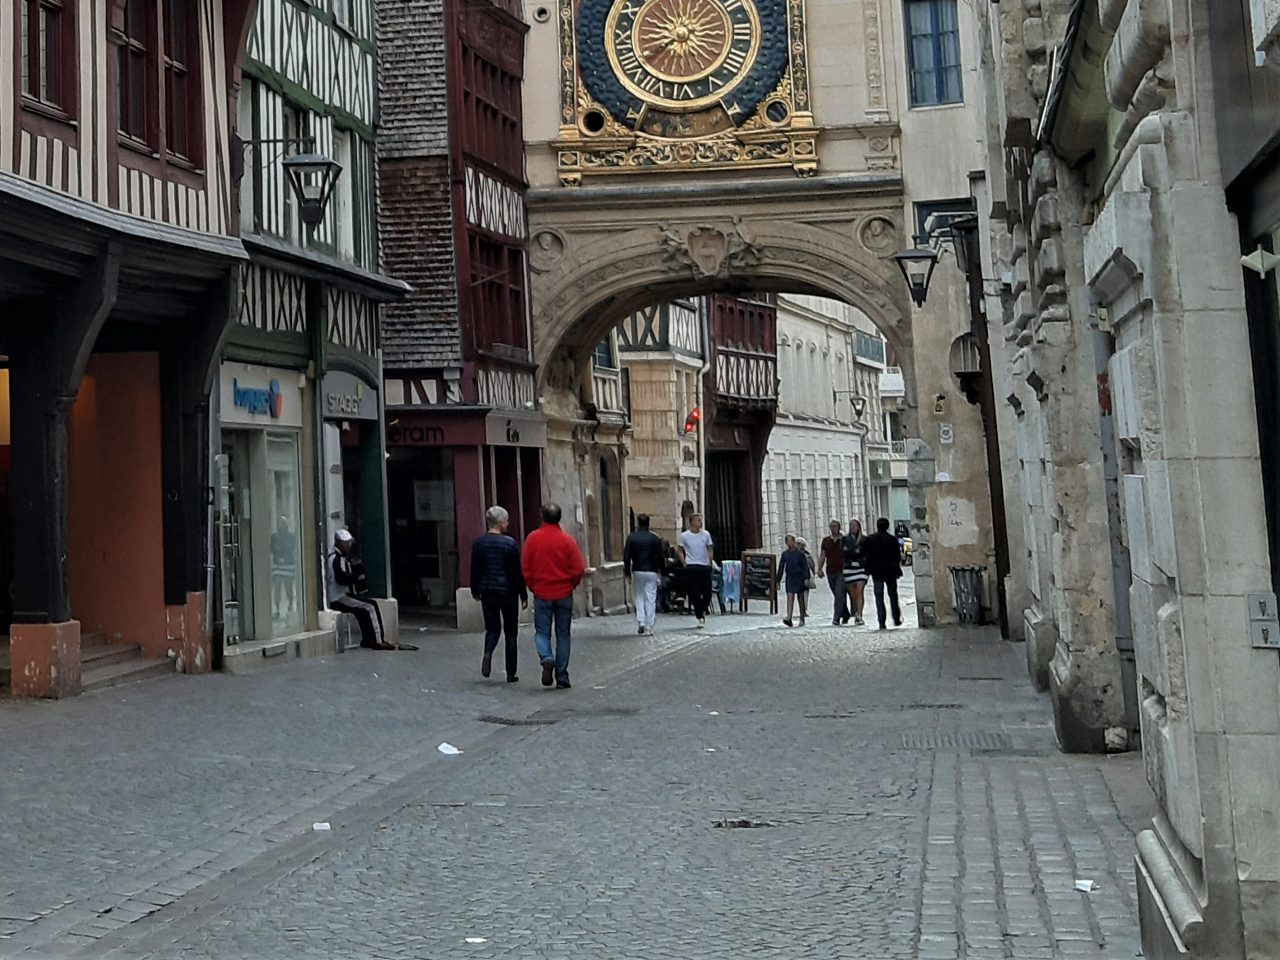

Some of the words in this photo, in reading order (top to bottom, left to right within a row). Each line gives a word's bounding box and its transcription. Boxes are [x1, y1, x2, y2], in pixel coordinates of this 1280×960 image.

[620, 1, 640, 20] X
[733, 23, 751, 40] III
[672, 84, 695, 100] VI
[708, 76, 724, 92] V
